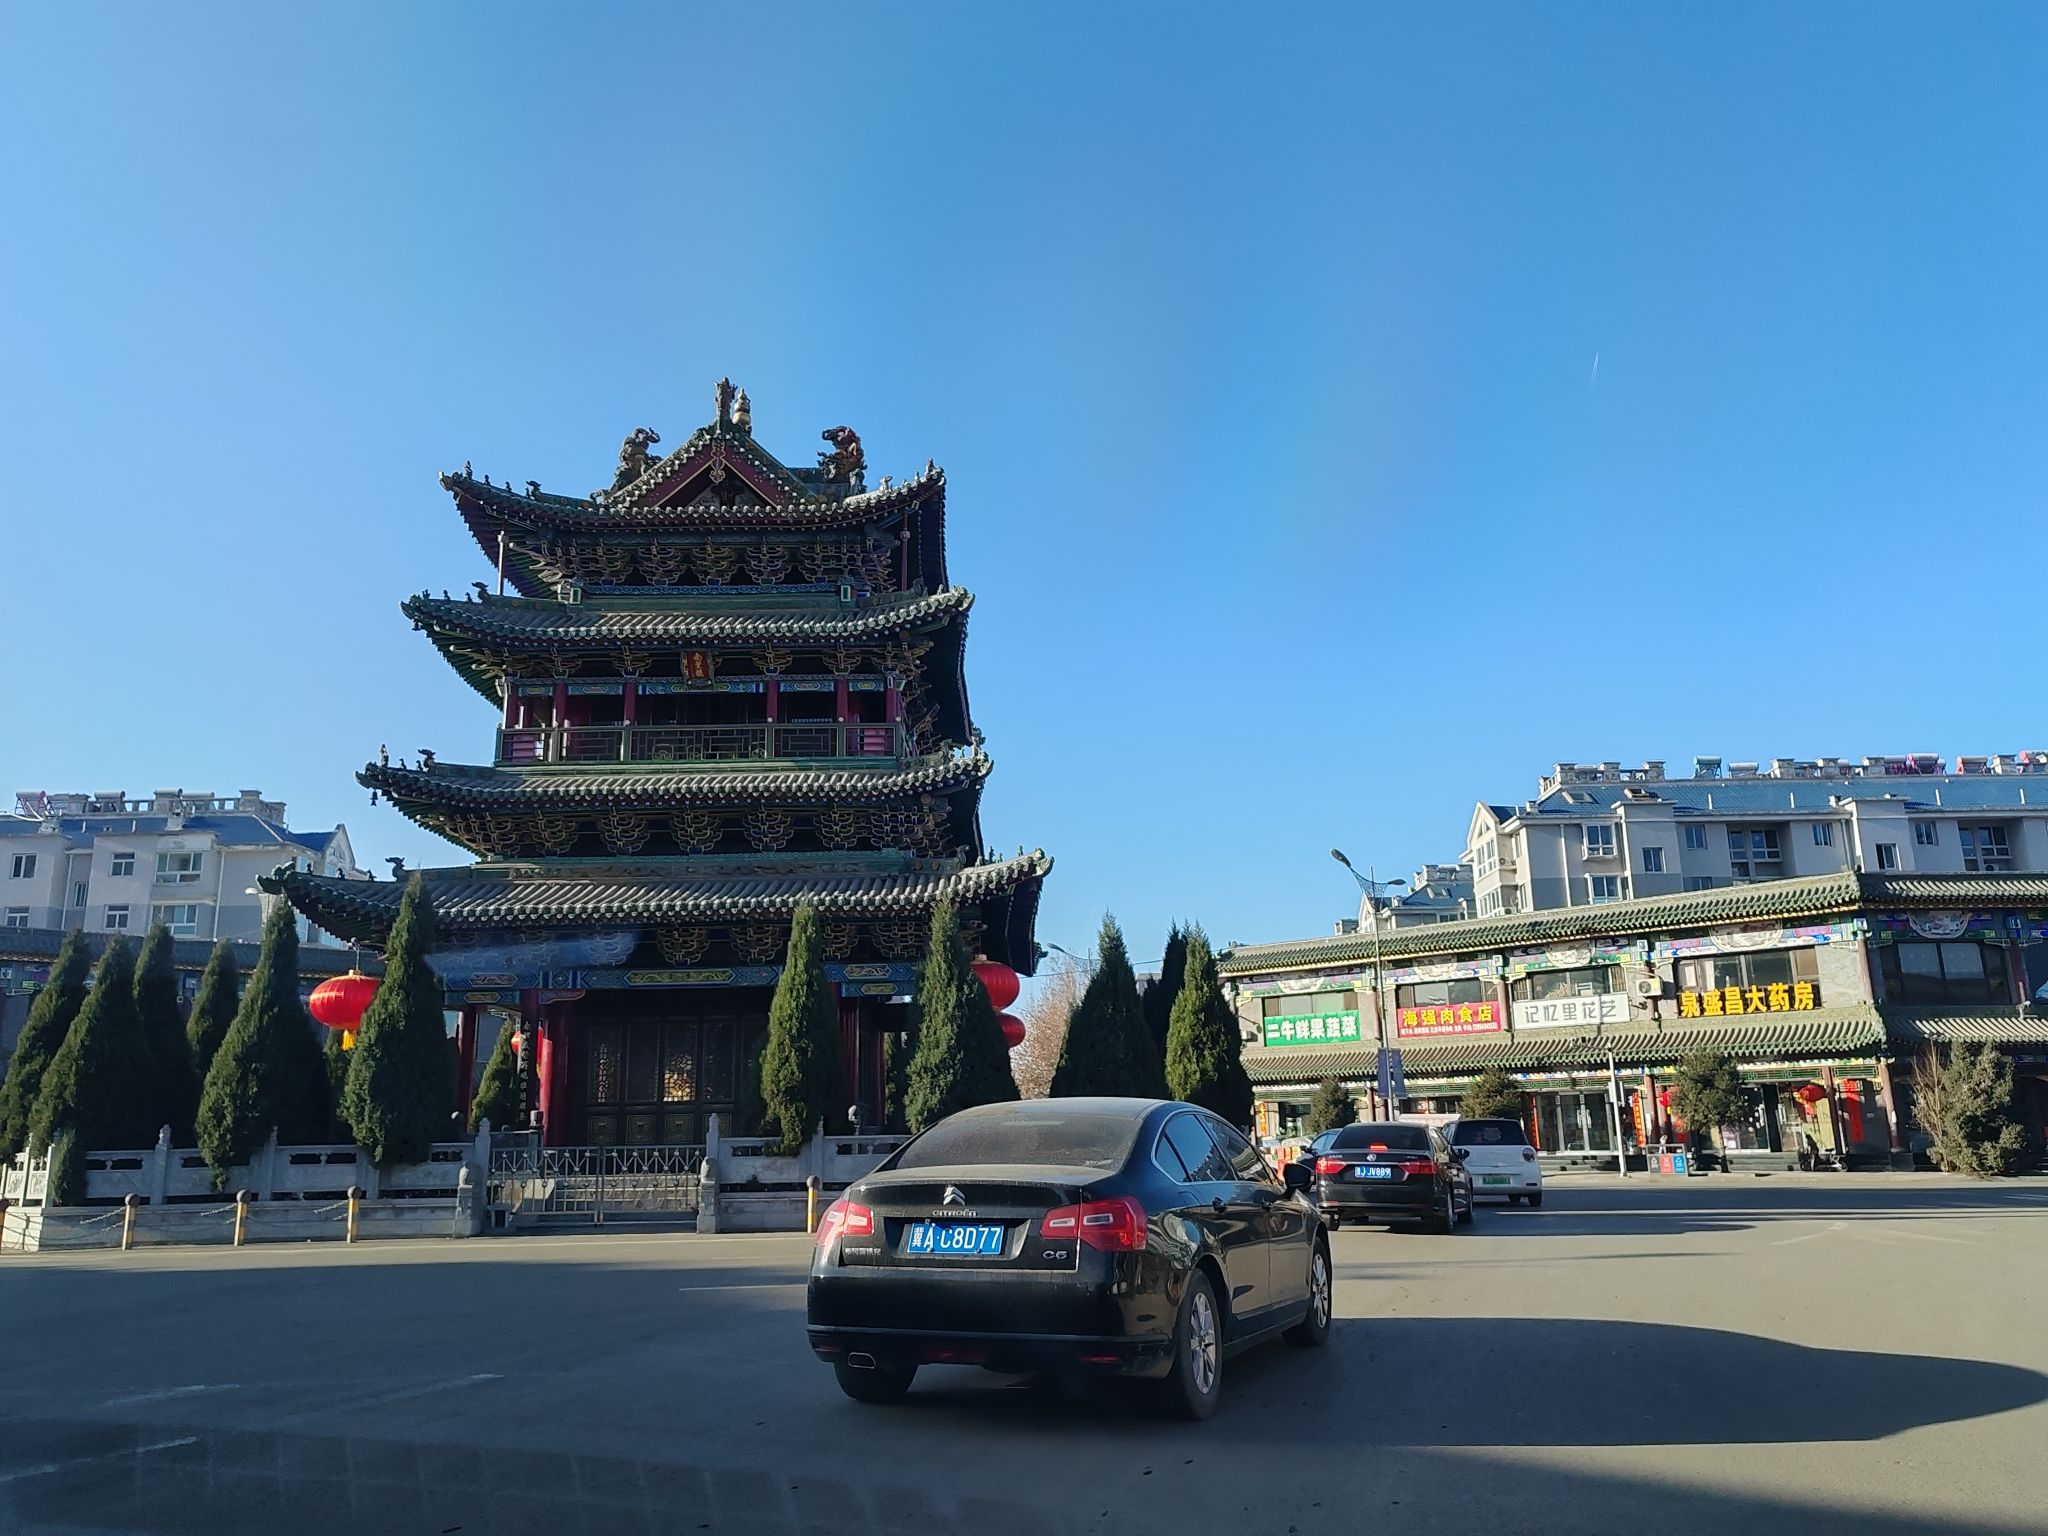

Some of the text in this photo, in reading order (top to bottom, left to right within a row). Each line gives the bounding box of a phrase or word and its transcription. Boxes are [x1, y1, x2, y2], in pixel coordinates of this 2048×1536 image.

[1524, 1000, 1617, 1024] 记忆里花艺
[1680, 981, 1814, 1018] 泉盛昌大药房
[1267, 1015, 1357, 1041] 二牛鲜果蔬菜
[1403, 1004, 1493, 1027] 海强肉食店
